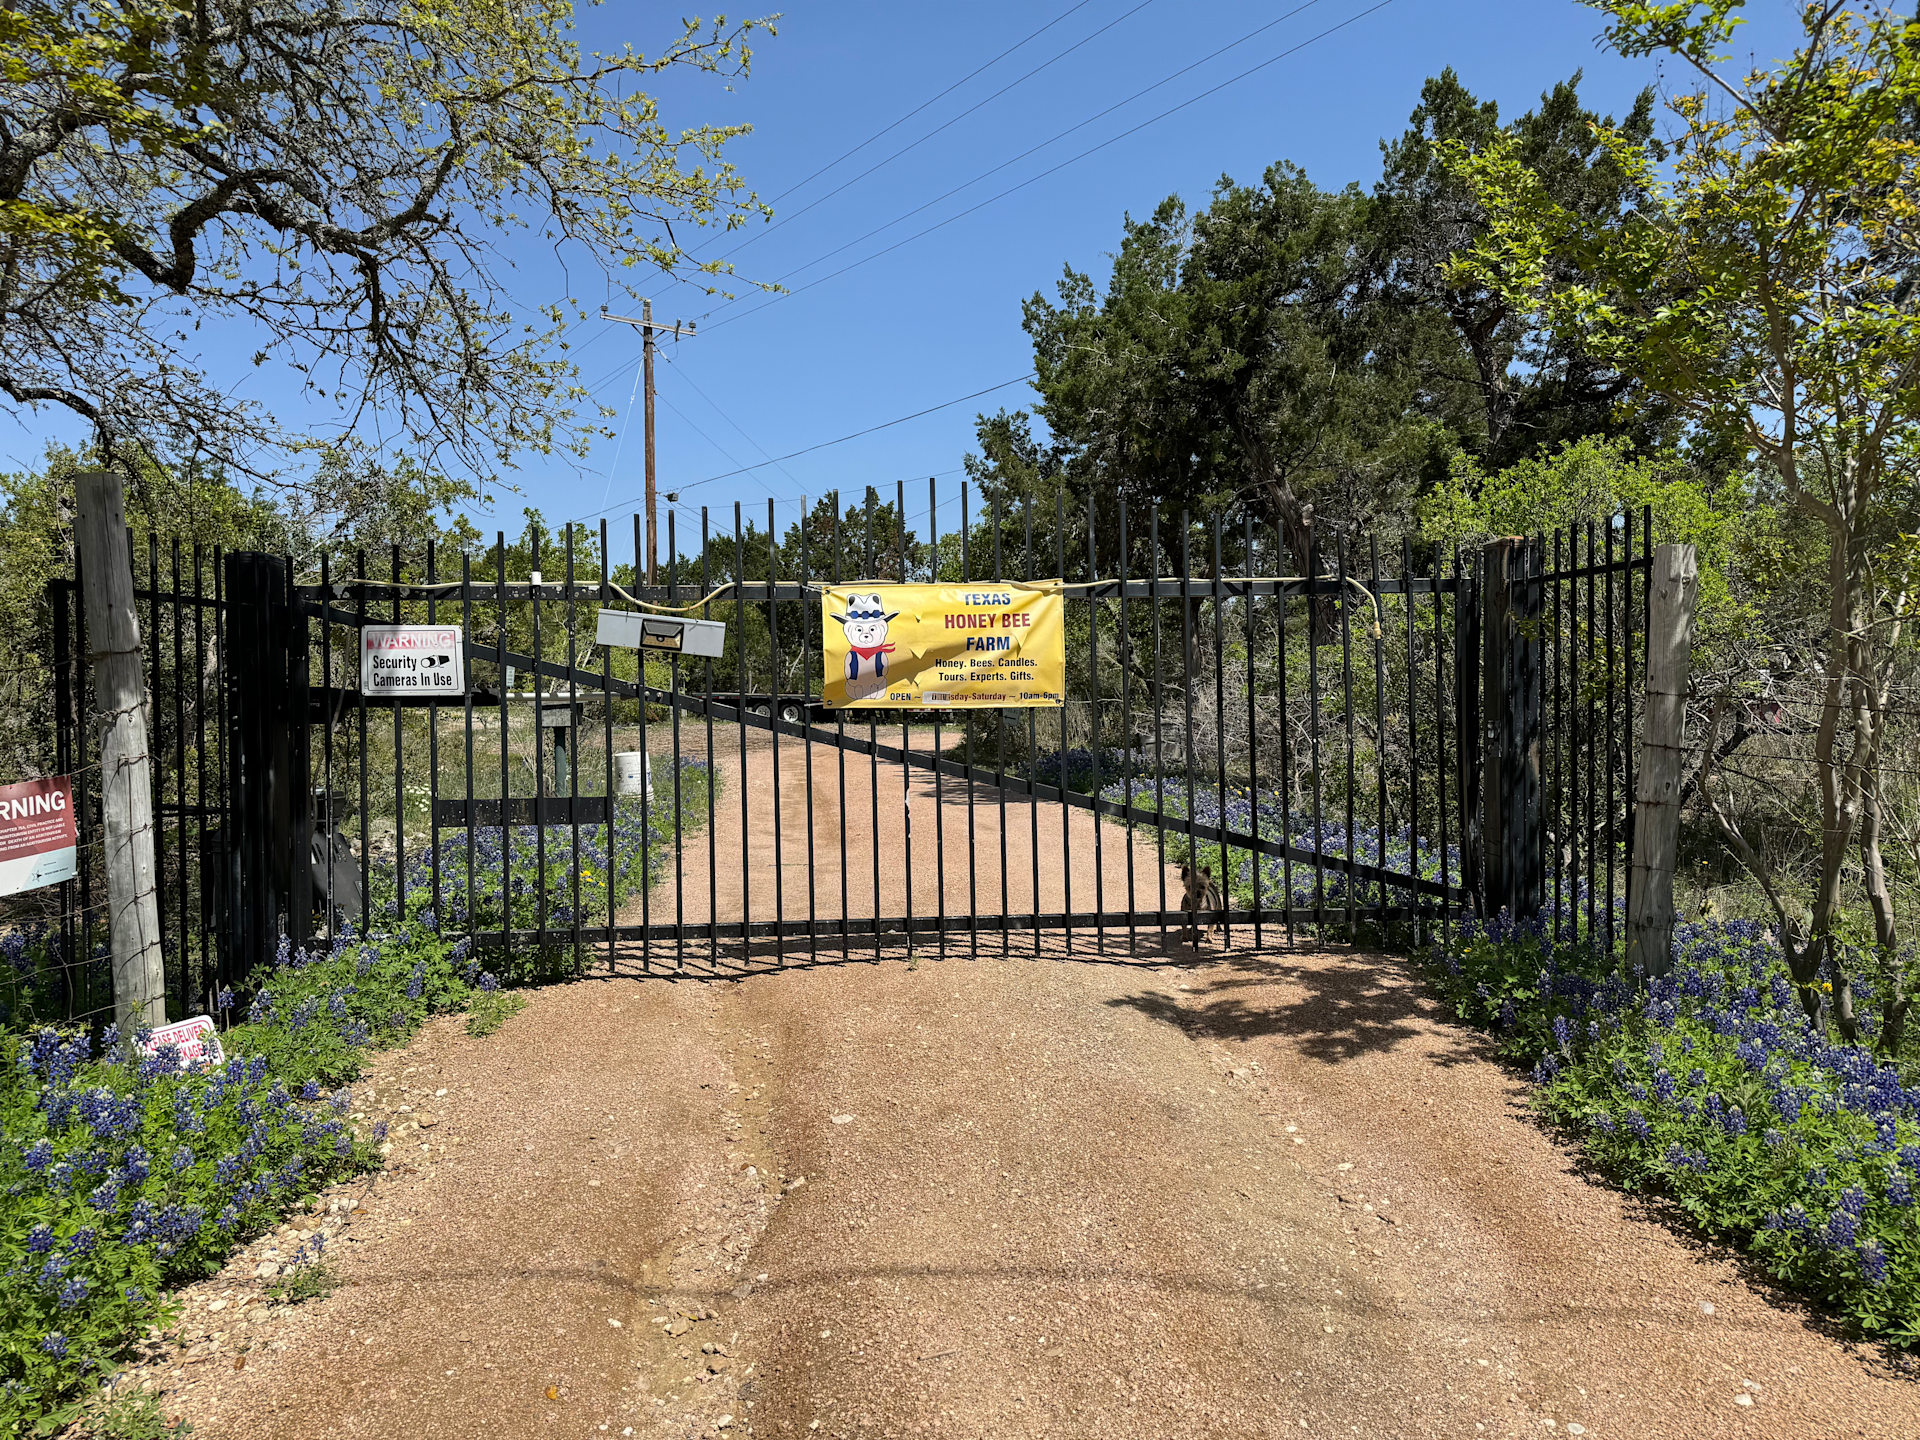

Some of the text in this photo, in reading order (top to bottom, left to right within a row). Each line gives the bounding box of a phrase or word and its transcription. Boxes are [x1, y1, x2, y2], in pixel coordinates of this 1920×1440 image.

[964, 592, 1011, 606] TEXAS
[944, 612, 1031, 629] HONEY BEE
[370, 632, 451, 648] WARNING
[965, 636, 1011, 651] FARM
[373, 654, 417, 672] Security
[935, 657, 1038, 670] Honey. Bees. Candles.
[373, 672, 417, 687] Cameras
[420, 672, 430, 686] In
[433, 672, 452, 686] Use
[938, 671, 1035, 683] Tours. Experts. Gifts.
[890, 692, 912, 701] OPEN
[145, 1033, 172, 1053] LEASE
